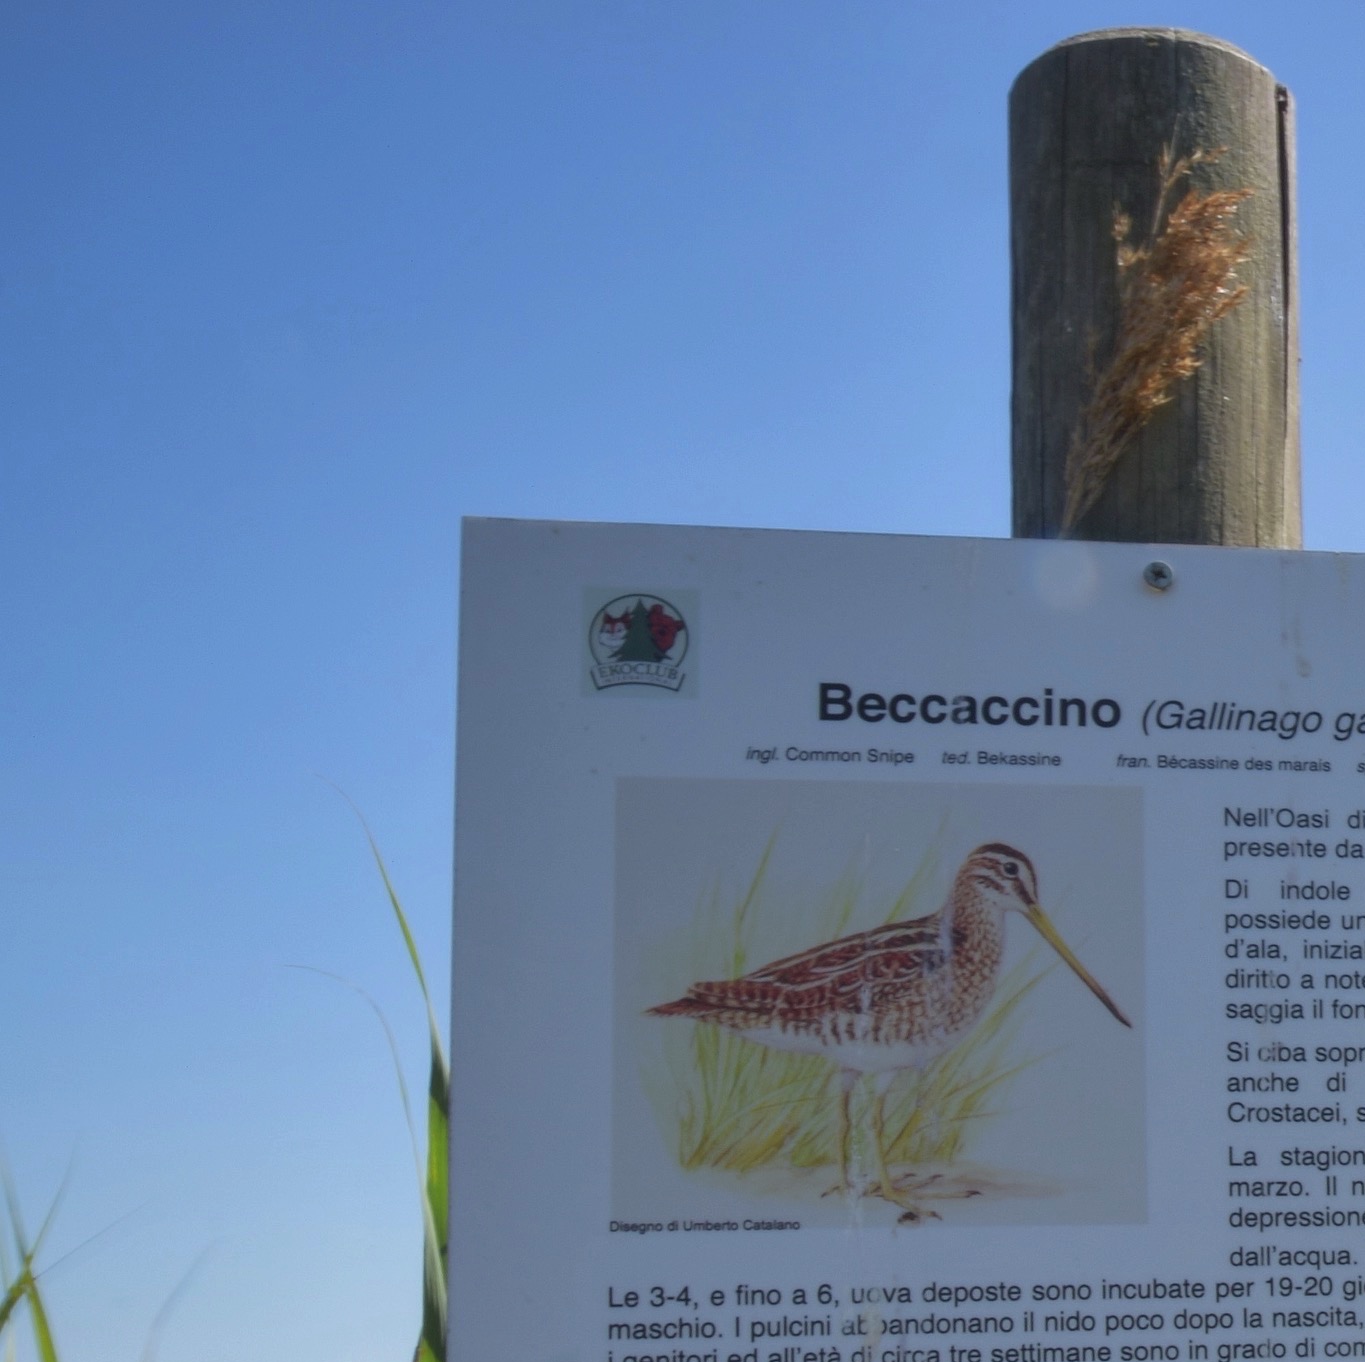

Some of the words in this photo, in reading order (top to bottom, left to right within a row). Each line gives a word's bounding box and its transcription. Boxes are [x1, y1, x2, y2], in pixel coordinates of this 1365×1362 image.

[600, 663, 678, 679] EKOCLUB
[819, 683, 1121, 728] Beccaccino
[1142, 700, 1323, 740] (Gallinago
[746, 747, 778, 764] ingl.
[785, 746, 861, 762] Common
[867, 748, 915, 766] Snipe
[942, 752, 970, 765] ted.
[977, 751, 1061, 766] Bekassine
[1117, 754, 1150, 768] fran.
[1245, 758, 1273, 771] des
[1278, 759, 1331, 772] marais
[1224, 807, 1329, 829] Nell'Oasi
[1281, 880, 1350, 901] indole
[1225, 910, 1331, 933] possiede
[1225, 939, 1287, 961] d'ala,
[1227, 1073, 1299, 1092] anche
[1227, 1102, 1347, 1125] Crostacei,
[1229, 1181, 1309, 1197] marzo.
[610, 1221, 663, 1234] Disegno
[683, 1221, 739, 1231] Umberto
[743, 1219, 800, 1231] Catalano
[1230, 1246, 1357, 1270] dall'acqua.
[650, 1286, 698, 1309] 3-4,
[735, 1284, 782, 1306] fino
[922, 1282, 1021, 1307] deposte
[1032, 1284, 1092, 1301] sono
[1102, 1279, 1205, 1300] incubate
[1216, 1282, 1254, 1303] per
[1266, 1276, 1333, 1297] 19-20
[608, 1318, 722, 1340] maschio.
[751, 1315, 831, 1343] pulcini
[1045, 1311, 1096, 1332] nido
[1105, 1314, 1164, 1336] poco
[1174, 1309, 1234, 1334] dopo
[1273, 1307, 1363, 1329] nascita,
[1121, 1345, 1179, 1361] sono
